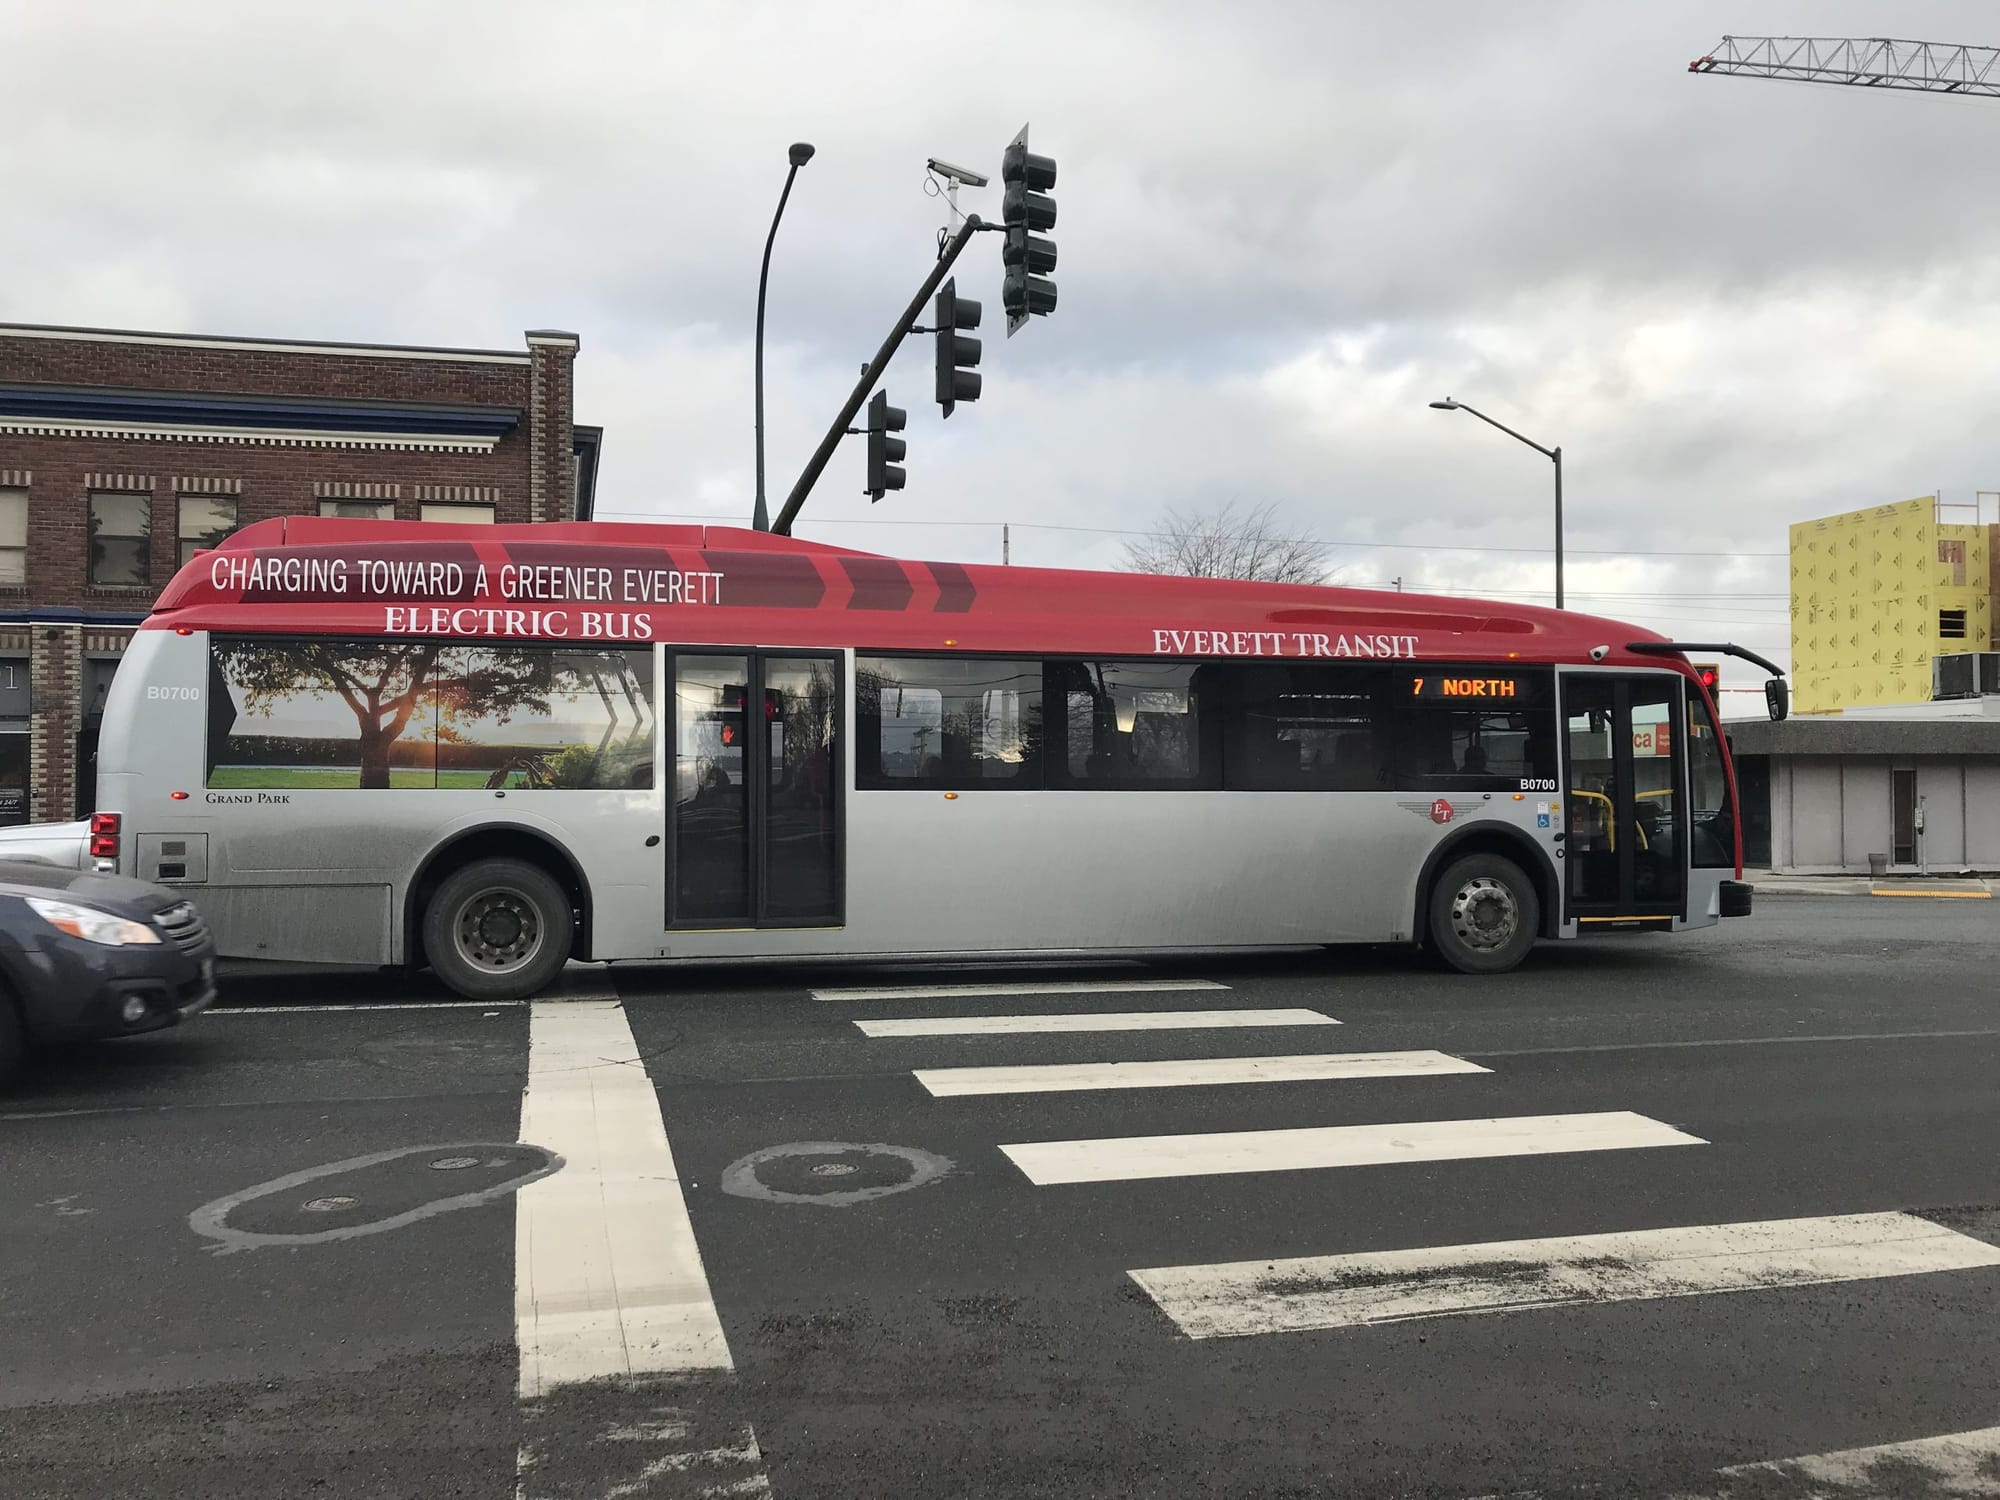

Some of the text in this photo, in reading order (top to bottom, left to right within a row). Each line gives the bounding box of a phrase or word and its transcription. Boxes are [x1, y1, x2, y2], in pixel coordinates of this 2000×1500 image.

[211, 557, 724, 604] CHARGING TOWARD A GREENER EVERETT
[384, 607, 653, 638] ELECTRIC BUS
[1153, 629, 1419, 658] EVERETT TRANSIT
[147, 686, 200, 701] B0700
[1413, 678, 1515, 696] 7 NORTH
[1520, 779, 1556, 790] B0700
